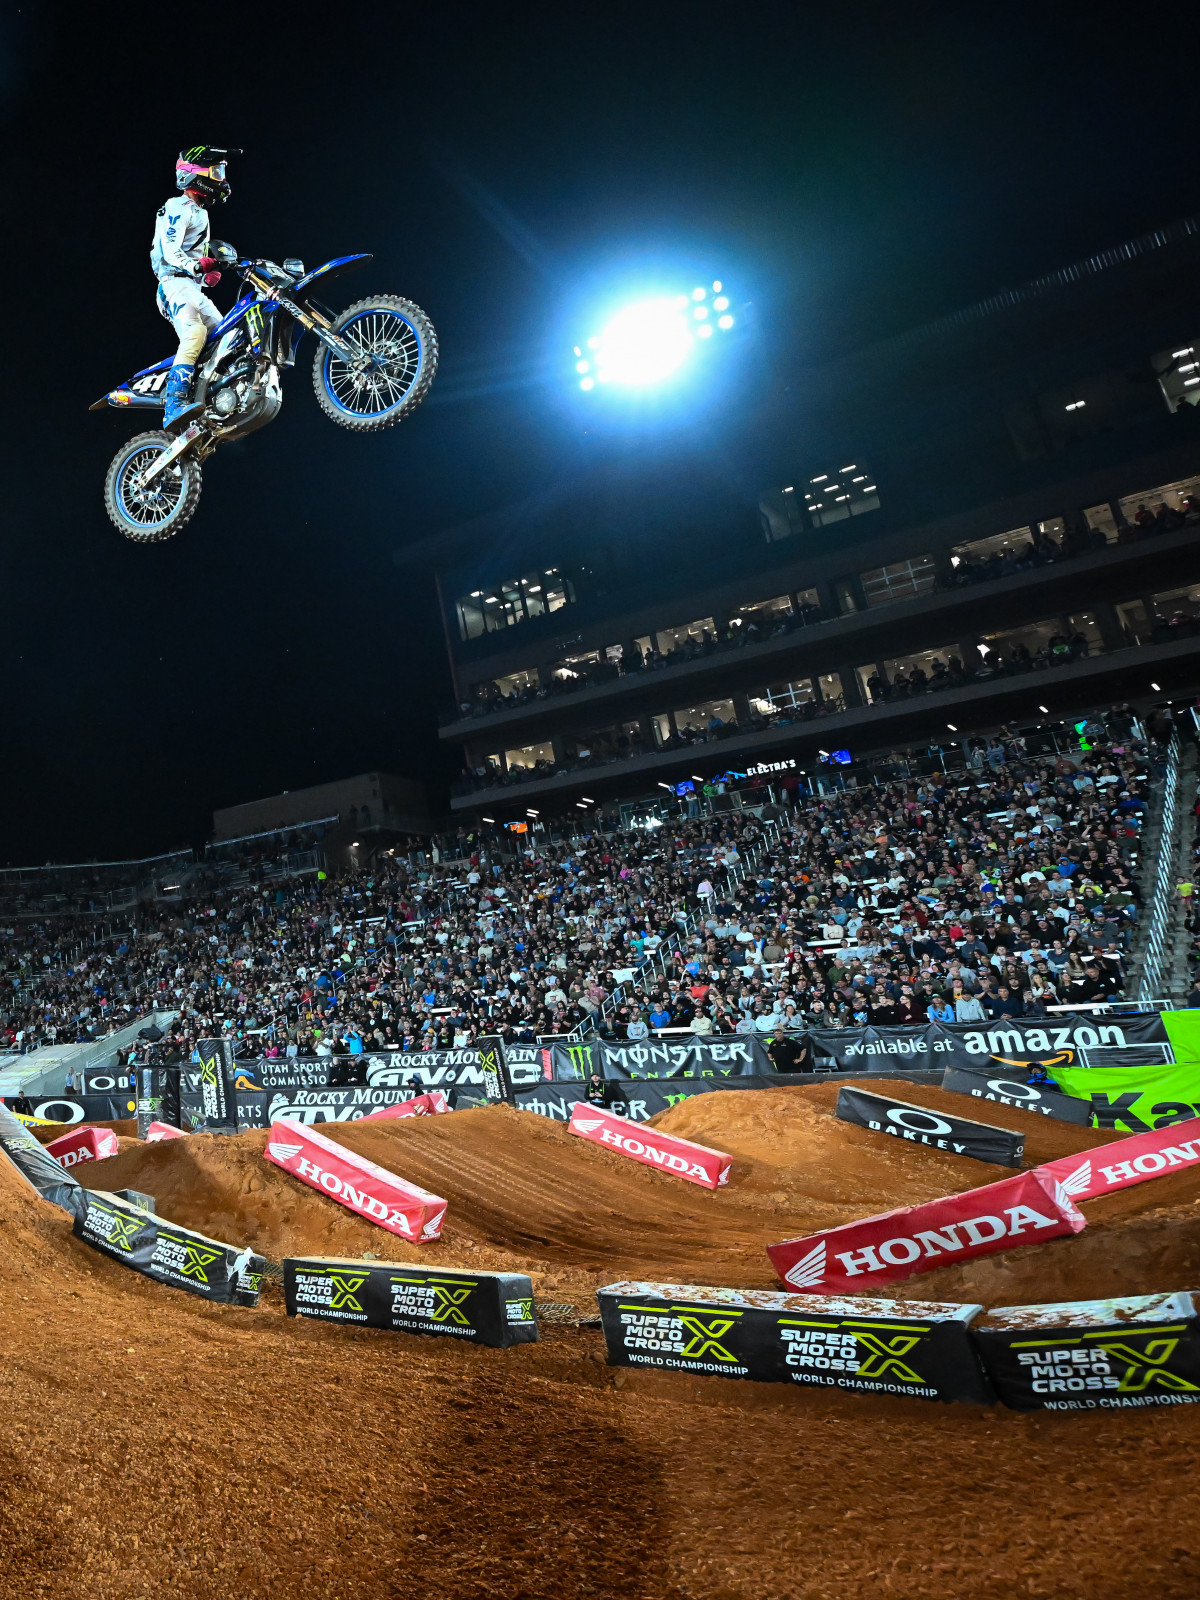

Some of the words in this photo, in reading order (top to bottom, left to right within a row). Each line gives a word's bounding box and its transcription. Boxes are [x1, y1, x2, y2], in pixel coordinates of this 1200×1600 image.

[132, 371, 170, 393] 41
[746, 759, 796, 777] ELECTRA'S
[844, 1038, 928, 1056] available
[933, 1039, 955, 1053] at
[963, 1024, 1125, 1055] amazon
[388, 1053, 442, 1068] ROCKY
[443, 1049, 539, 1065] MOUAIN
[605, 1042, 754, 1068] MONSTER
[261, 1063, 289, 1074] UTAH
[262, 1075, 327, 1087] COMMISSIO
[292, 1089, 349, 1105] ROCKY
[971, 1088, 1052, 1115] OAKLEY
[237, 1104, 262, 1118] RTS
[868, 1119, 967, 1153] OAKLEY
[55, 1146, 95, 1169] NDA
[600, 1128, 712, 1183] HONDA
[1097, 1138, 1200, 1185] HON
[296, 1156, 414, 1236] HONDA
[86, 1206, 116, 1225] SUPER
[86, 1214, 113, 1230] MOTO
[83, 1220, 112, 1239] CROSS
[81, 1230, 98, 1244] WORLD
[98, 1239, 135, 1259] CHAMPIONSHIP
[155, 1237, 187, 1256] SUPER
[834, 1204, 1059, 1277] HONDA
[151, 1252, 185, 1270] CROSS
[155, 1246, 184, 1263] MOTO
[150, 1263, 170, 1276] WORLD
[169, 1271, 211, 1292] CHAMPIONSHIP
[295, 1274, 334, 1287] SUPER
[298, 1284, 331, 1295] MOTO
[390, 1284, 435, 1298] SUPER
[295, 1293, 333, 1305] CROSS
[394, 1294, 434, 1308] MOTO
[296, 1306, 319, 1317] WORLD
[319, 1309, 368, 1322] CHAMPIONSHIP
[391, 1304, 435, 1318] CROSS
[392, 1318, 417, 1329] WORLD
[418, 1321, 477, 1336] CHAMPIONSHIP
[620, 1313, 683, 1329] SUPER
[626, 1325, 683, 1341] MOTO
[780, 1328, 858, 1347] SUPER
[623, 1336, 686, 1353] CROSS
[788, 1342, 856, 1359] MOTO
[628, 1353, 664, 1365] WORLD
[665, 1358, 749, 1375] CHAMPIONSHIP
[785, 1354, 861, 1372] CROSS
[1017, 1348, 1110, 1366] SUPER
[1031, 1362, 1112, 1379] MOTO
[791, 1372, 835, 1386] WORLD
[837, 1378, 938, 1397] CHAMPIONSHIP
[1031, 1376, 1122, 1393] CROSS
[1100, 1394, 1200, 1409] CHAMPIONSH
